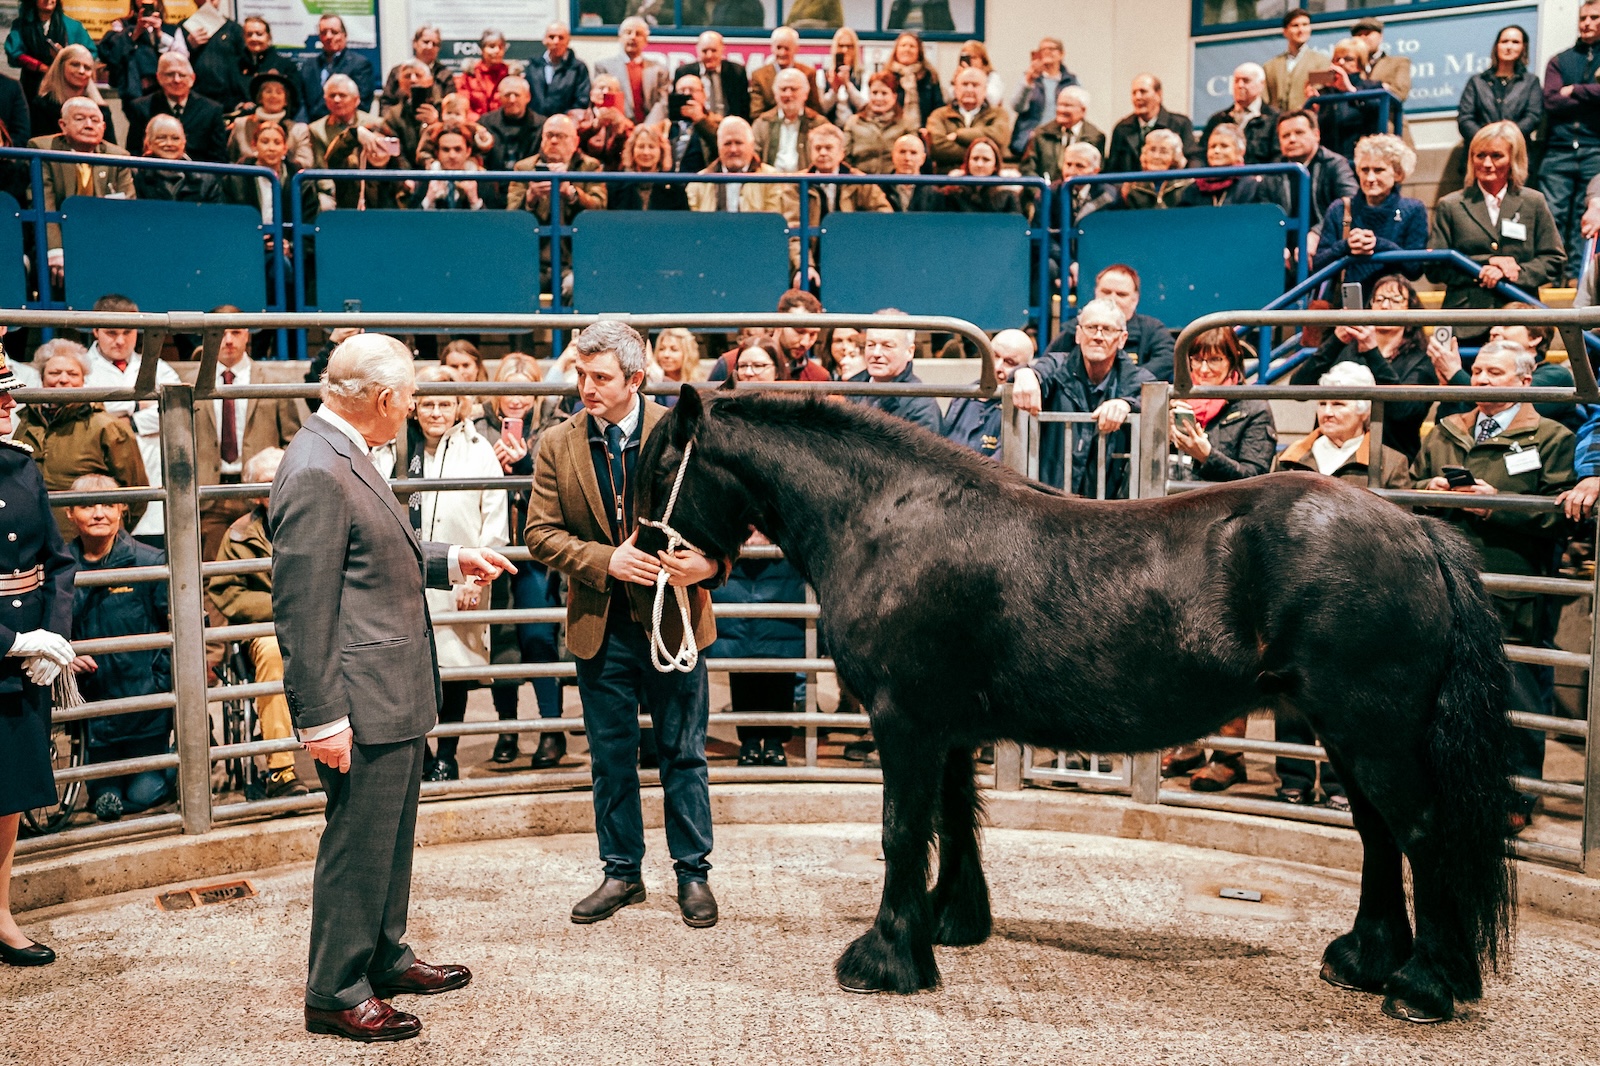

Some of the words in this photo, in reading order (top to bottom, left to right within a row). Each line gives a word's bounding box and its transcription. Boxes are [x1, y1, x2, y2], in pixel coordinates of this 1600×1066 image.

[1397, 39, 1419, 52] to
[1444, 52, 1492, 75] Ma
[1410, 83, 1453, 98] co.uk
